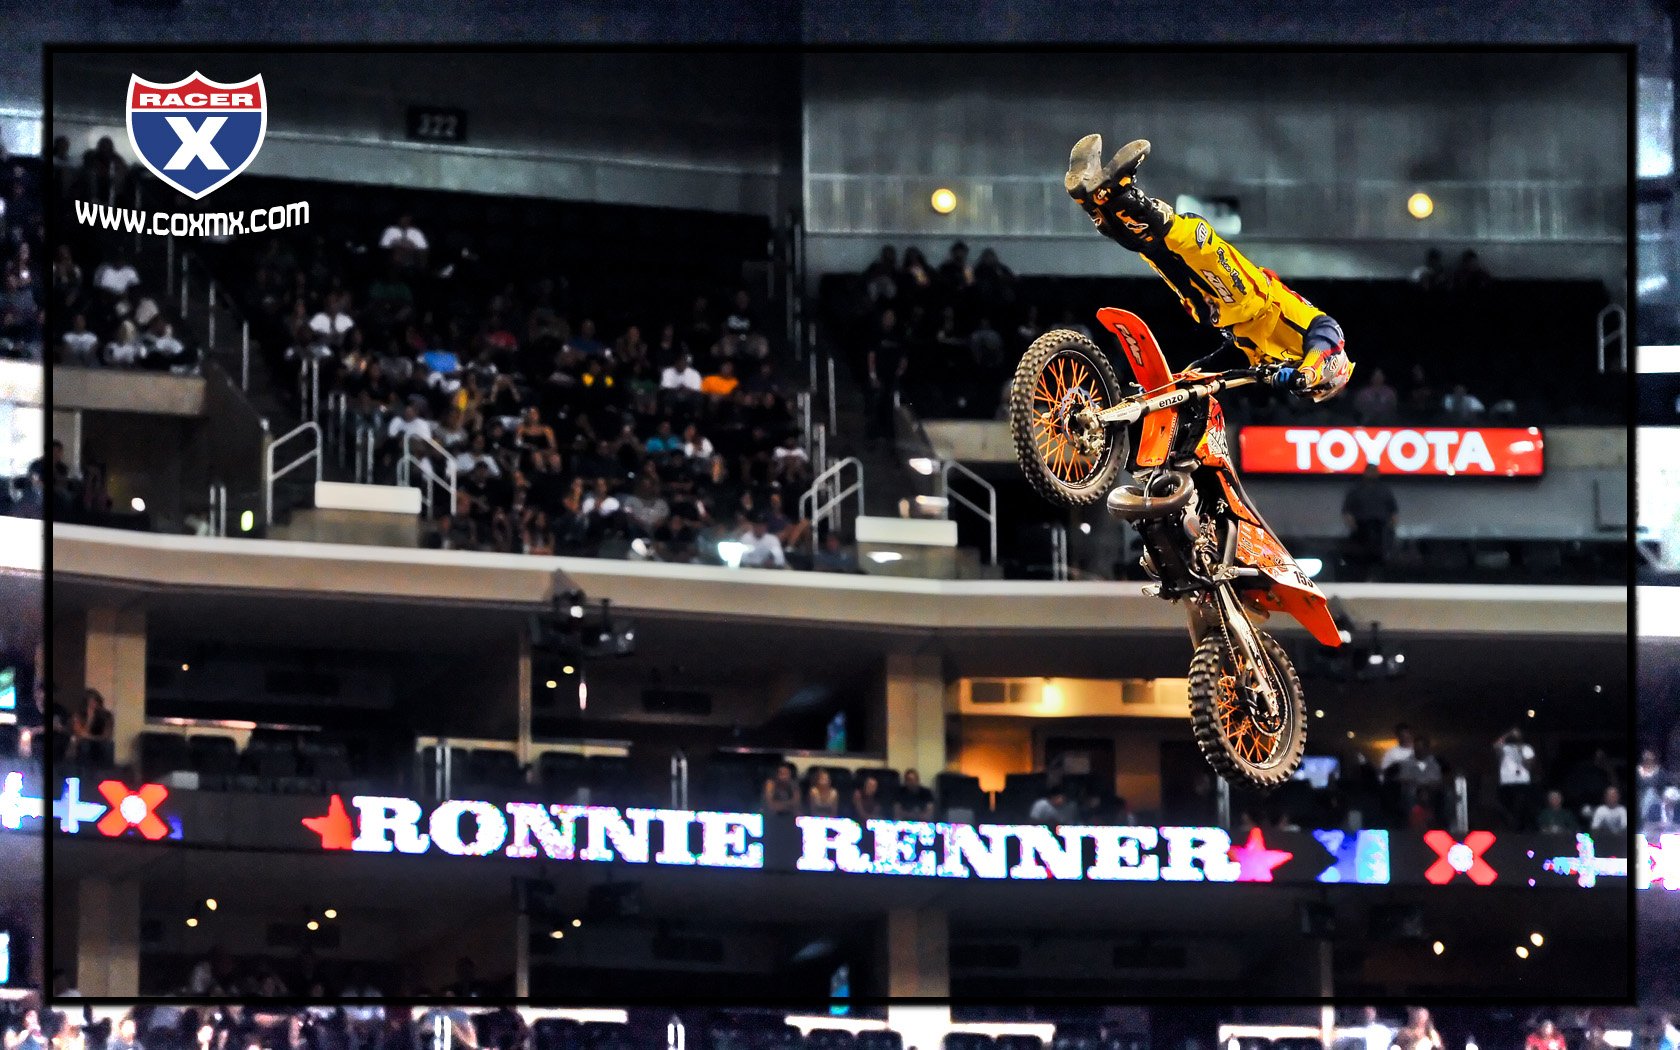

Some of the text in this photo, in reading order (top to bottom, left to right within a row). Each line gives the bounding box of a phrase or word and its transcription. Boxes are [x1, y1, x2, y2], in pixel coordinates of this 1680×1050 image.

[1159, 393, 1184, 408] enzo
[1284, 428, 1496, 472] TOYOTA
[352, 795, 1242, 882] RONNIE RENNER
